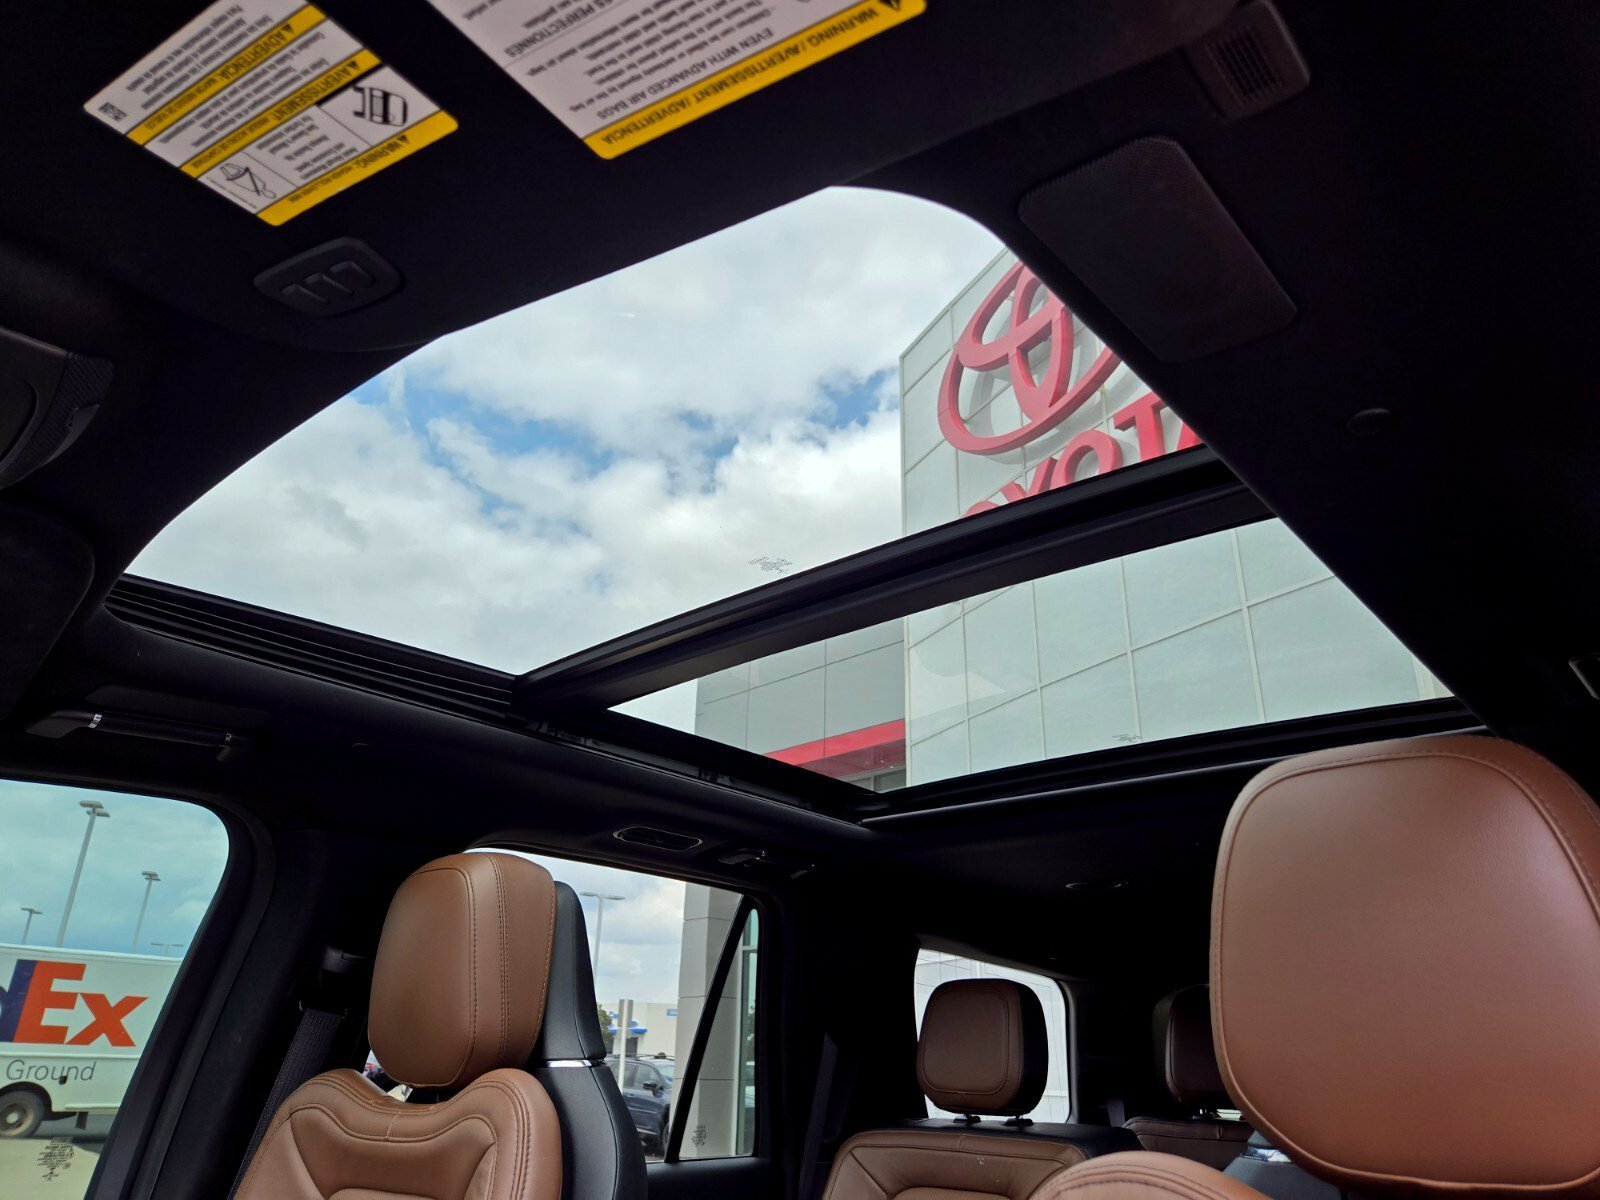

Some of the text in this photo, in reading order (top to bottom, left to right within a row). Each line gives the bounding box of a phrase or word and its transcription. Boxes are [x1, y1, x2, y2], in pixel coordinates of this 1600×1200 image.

[215, 31, 287, 82] ADVERTENCIA:
[503, 4, 597, 59] PERFECTIONNÉS
[267, 66, 351, 121] AVERTISSEMENT:
[595, 28, 774, 119] EVEN WITH ADVANCED AIR BAGS
[599, 7, 879, 145] WARNING /AVERTISSEMENT /ADVERTENCIA
[351, 139, 403, 170] WARNING:
[6, 1059, 97, 1082] Ground
